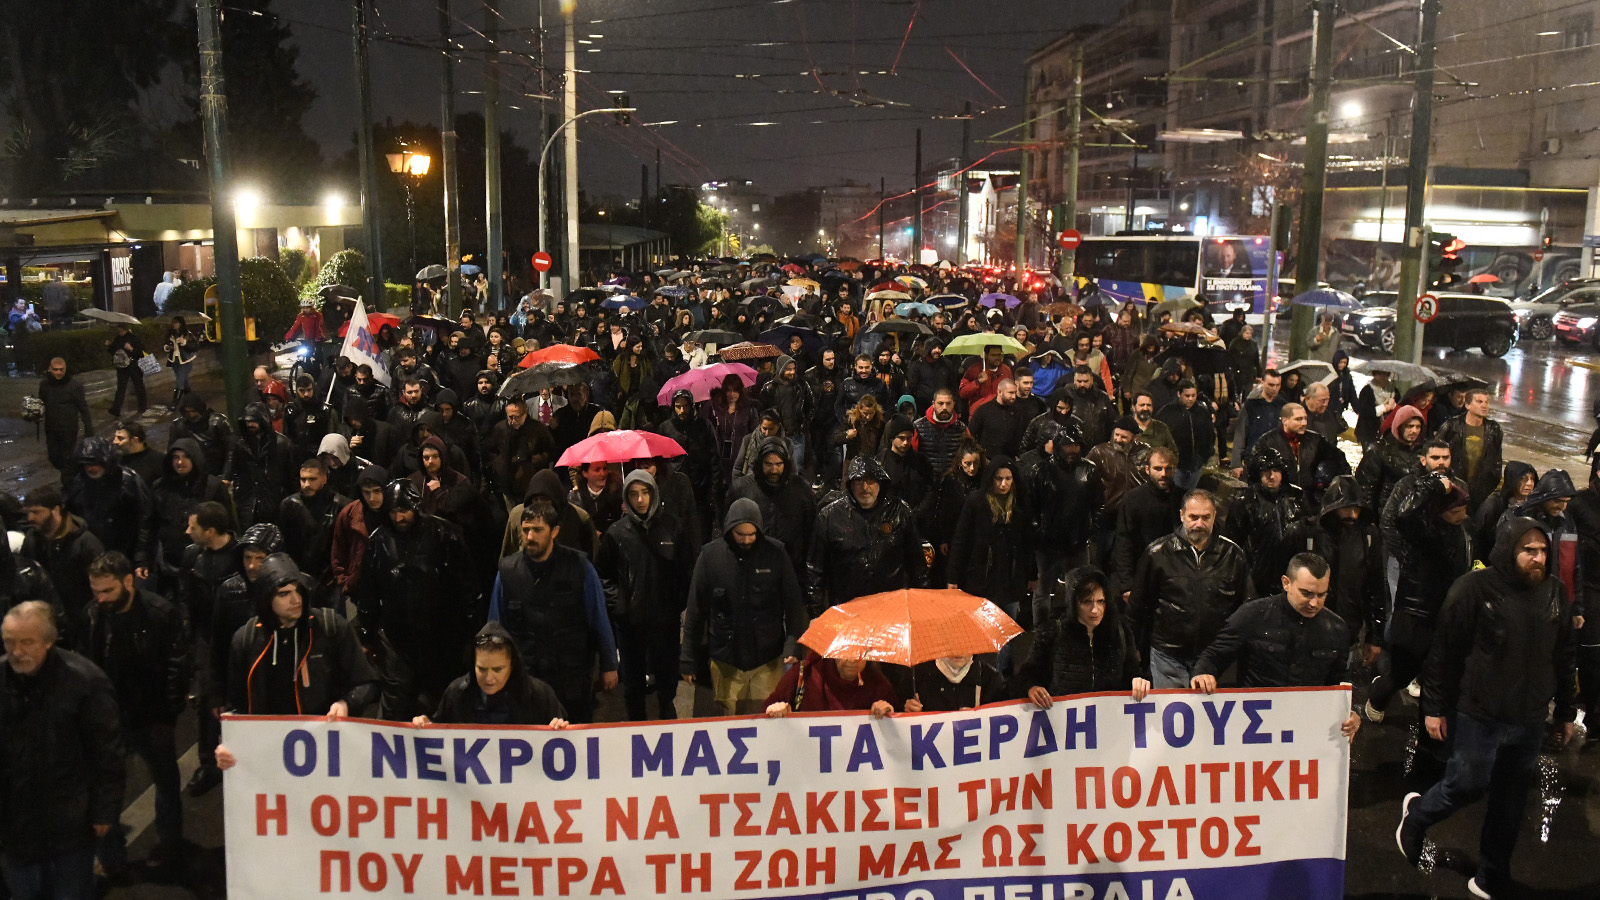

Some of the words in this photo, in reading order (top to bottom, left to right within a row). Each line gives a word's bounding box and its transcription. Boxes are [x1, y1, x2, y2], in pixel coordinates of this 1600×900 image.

[283, 730, 340, 777] ΟΙ
[372, 733, 601, 785] ΝΕΚΡΟΙ
[631, 727, 781, 786] ΜΑΣ,
[809, 724, 883, 773] ΤΑ
[911, 705, 1099, 771] ΚΕΡΔΗ
[1124, 700, 1294, 749] ΤΟΥΣ.
[255, 793, 288, 836] Η
[310, 794, 448, 840] ΟΡΓΗ
[470, 799, 583, 844] ΜΑΣ
[605, 795, 680, 842] ΝΑ
[699, 786, 940, 838] ΤΣΑΚΙΣΕΙ
[958, 767, 1053, 823] ΤΗΝ
[1074, 758, 1319, 810] ΠΟΛΙΤΙΚΗ
[320, 849, 423, 894] ΠΟΥ
[445, 854, 626, 897] ΜΕΤΡΑ
[645, 852, 712, 895] ΤΗ
[734, 846, 836, 891] ΖΩΗ
[858, 833, 962, 882] ΜΑΣ
[982, 823, 1046, 868] ΩΣ
[1066, 814, 1262, 866] ΚΟΣΤΟΣ
